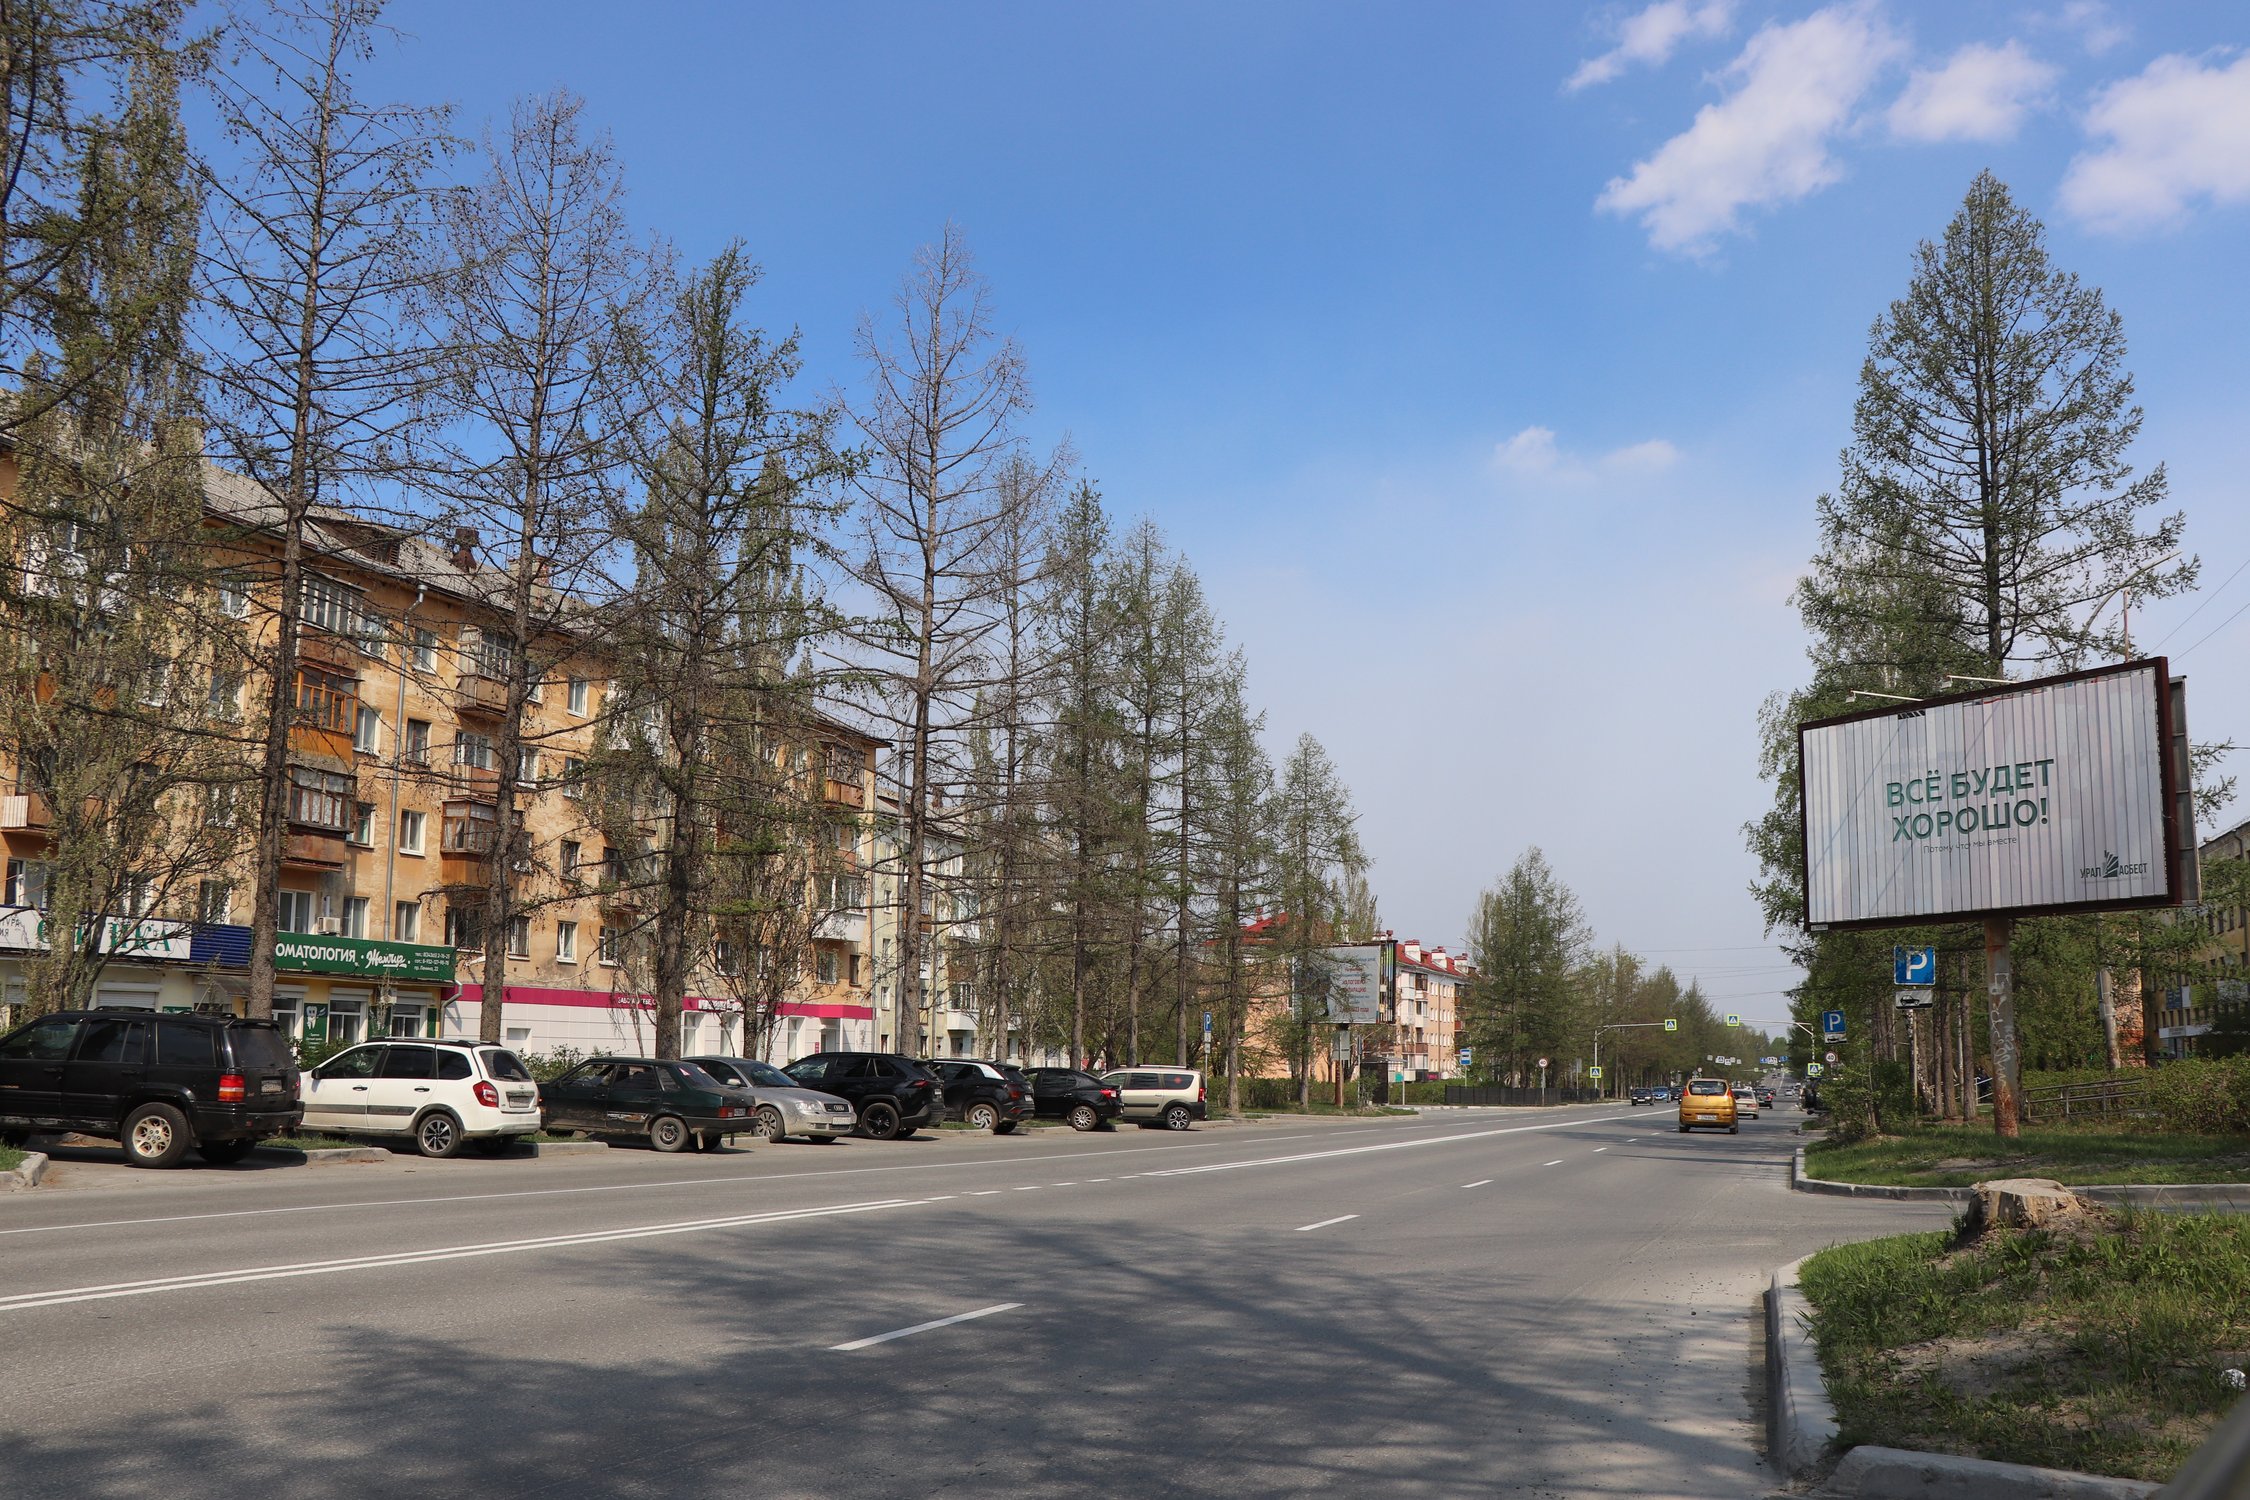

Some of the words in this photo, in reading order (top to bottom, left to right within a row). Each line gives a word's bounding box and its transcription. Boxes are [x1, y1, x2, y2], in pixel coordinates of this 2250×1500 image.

[1886, 769, 1942, 807] ВСЁ
[1951, 758, 2054, 799] БУДЕТ
[1892, 797, 2048, 842] ХОРОШО!
[1923, 843, 1954, 854] Потому
[1955, 841, 1970, 850] что
[1973, 840, 1985, 848] мы
[1987, 836, 2017, 846] вместе
[2079, 867, 2101, 878] УРАЛ
[2119, 863, 2148, 875] АСБЕСТ
[275, 942, 356, 963] ОМАТОЛОГИЯ
[1906, 950, 1928, 980] P
[1829, 1013, 1840, 1031] P
